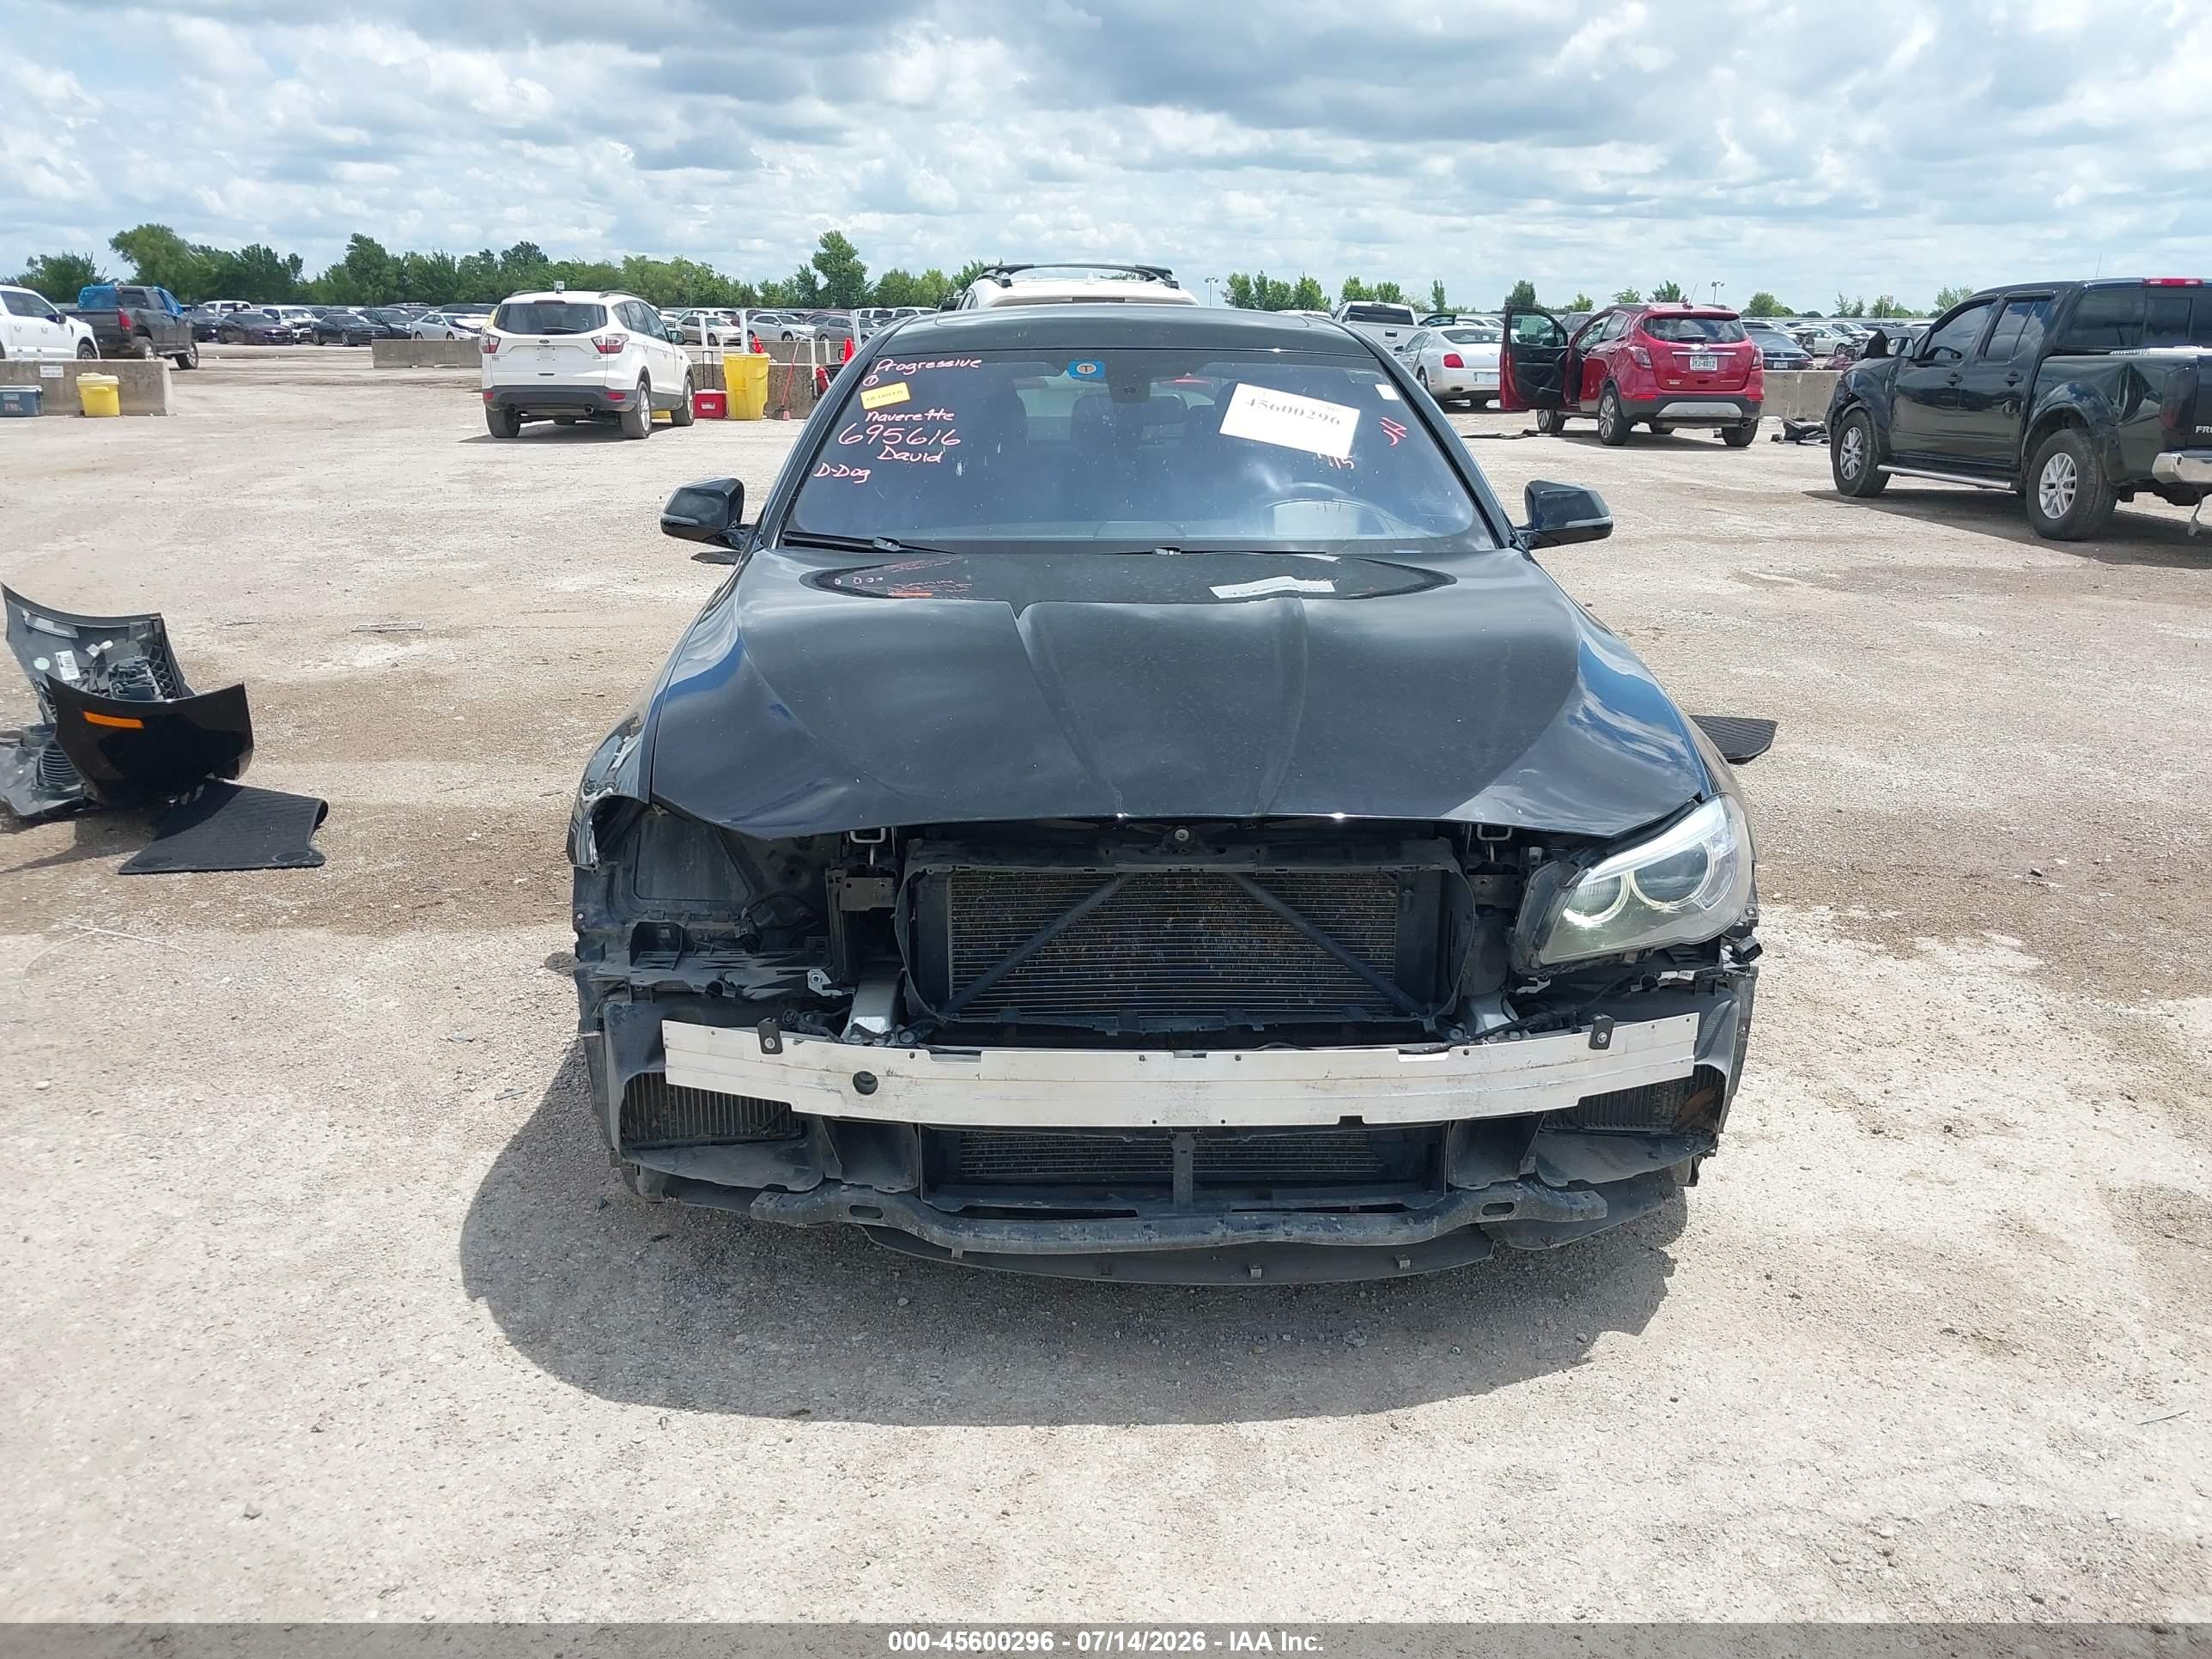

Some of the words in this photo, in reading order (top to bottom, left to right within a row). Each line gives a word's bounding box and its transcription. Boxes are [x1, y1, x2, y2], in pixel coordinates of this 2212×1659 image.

[872, 358, 982, 375] Progressive
[838, 422, 961, 446] 695616
[2195, 425, 2212, 434] FR
[877, 445, 944, 463] David
